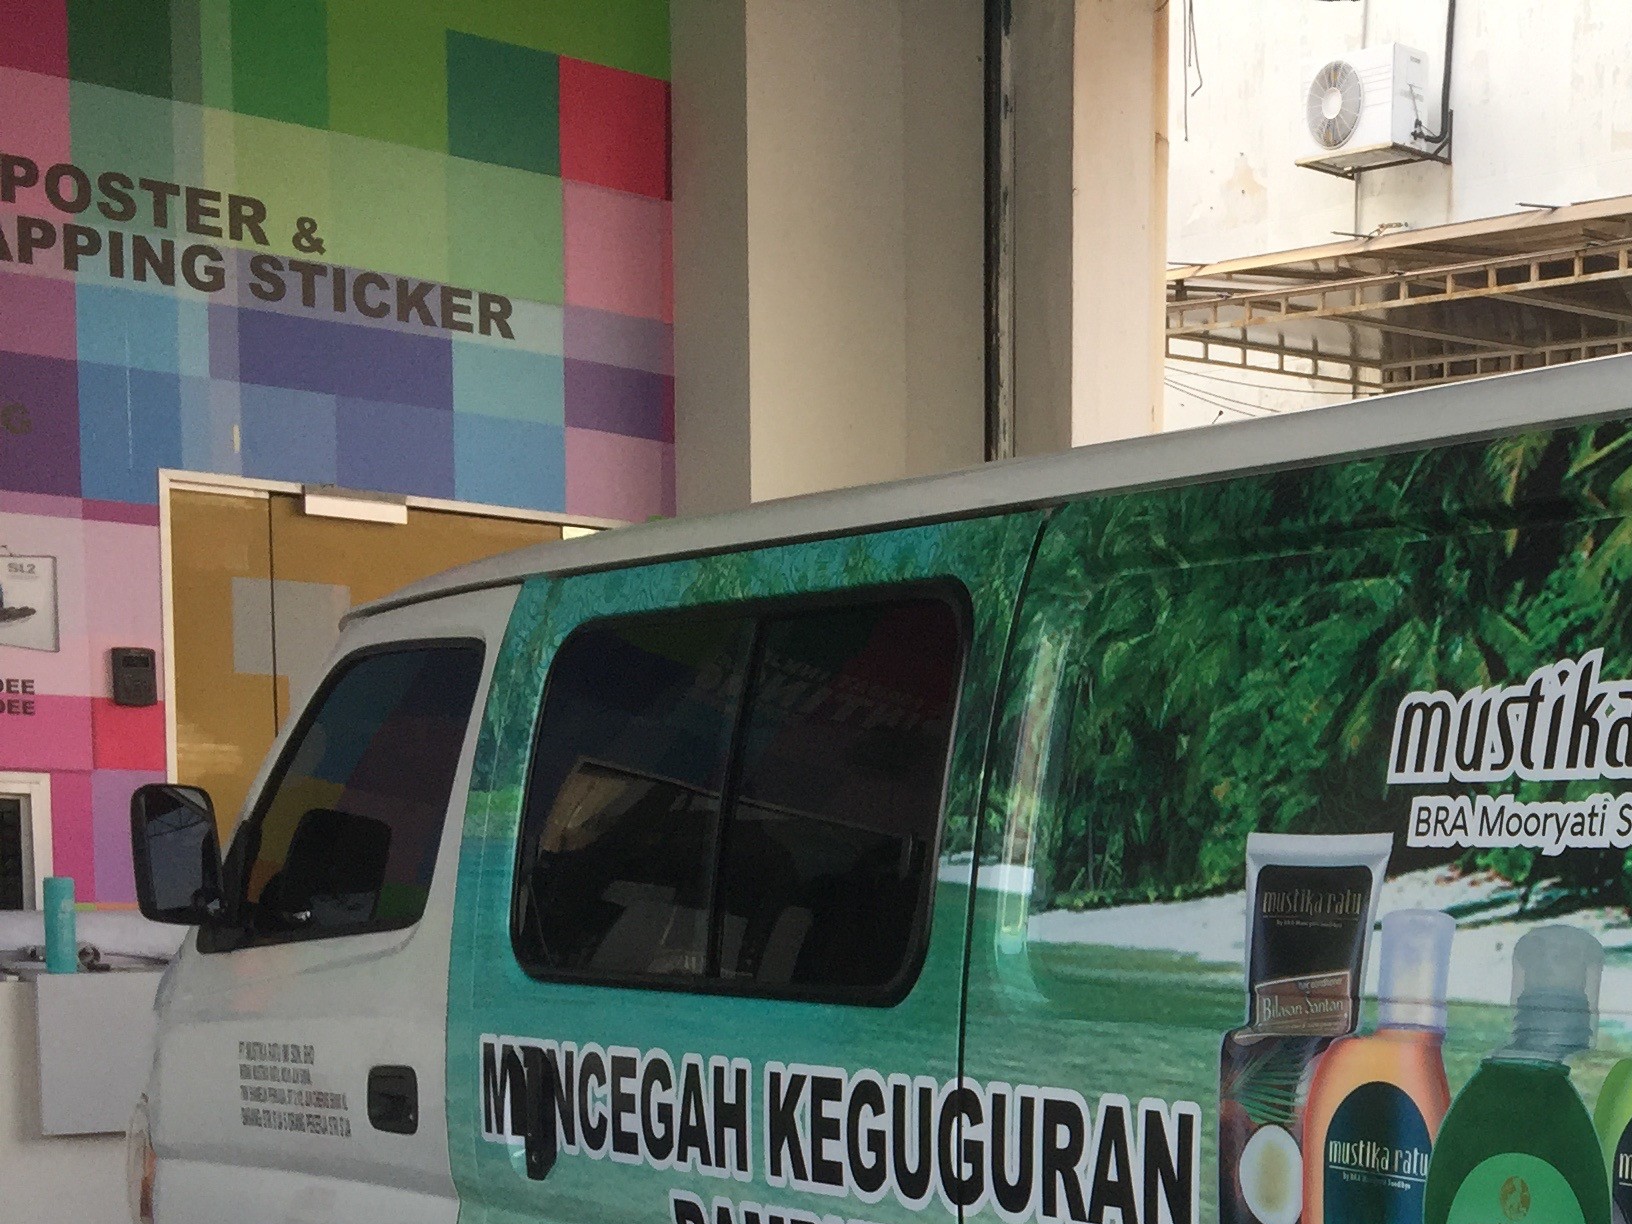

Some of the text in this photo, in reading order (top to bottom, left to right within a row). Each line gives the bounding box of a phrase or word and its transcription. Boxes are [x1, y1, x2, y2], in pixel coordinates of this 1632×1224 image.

[0, 154, 326, 254] POSTER &
[249, 253, 515, 340] STICKER
[1415, 806, 1467, 838] BRA
[1479, 804, 1605, 844] Mooryati
[483, 1041, 749, 1173] MNCEGAH
[1329, 1140, 1428, 1177] mustika ratu
